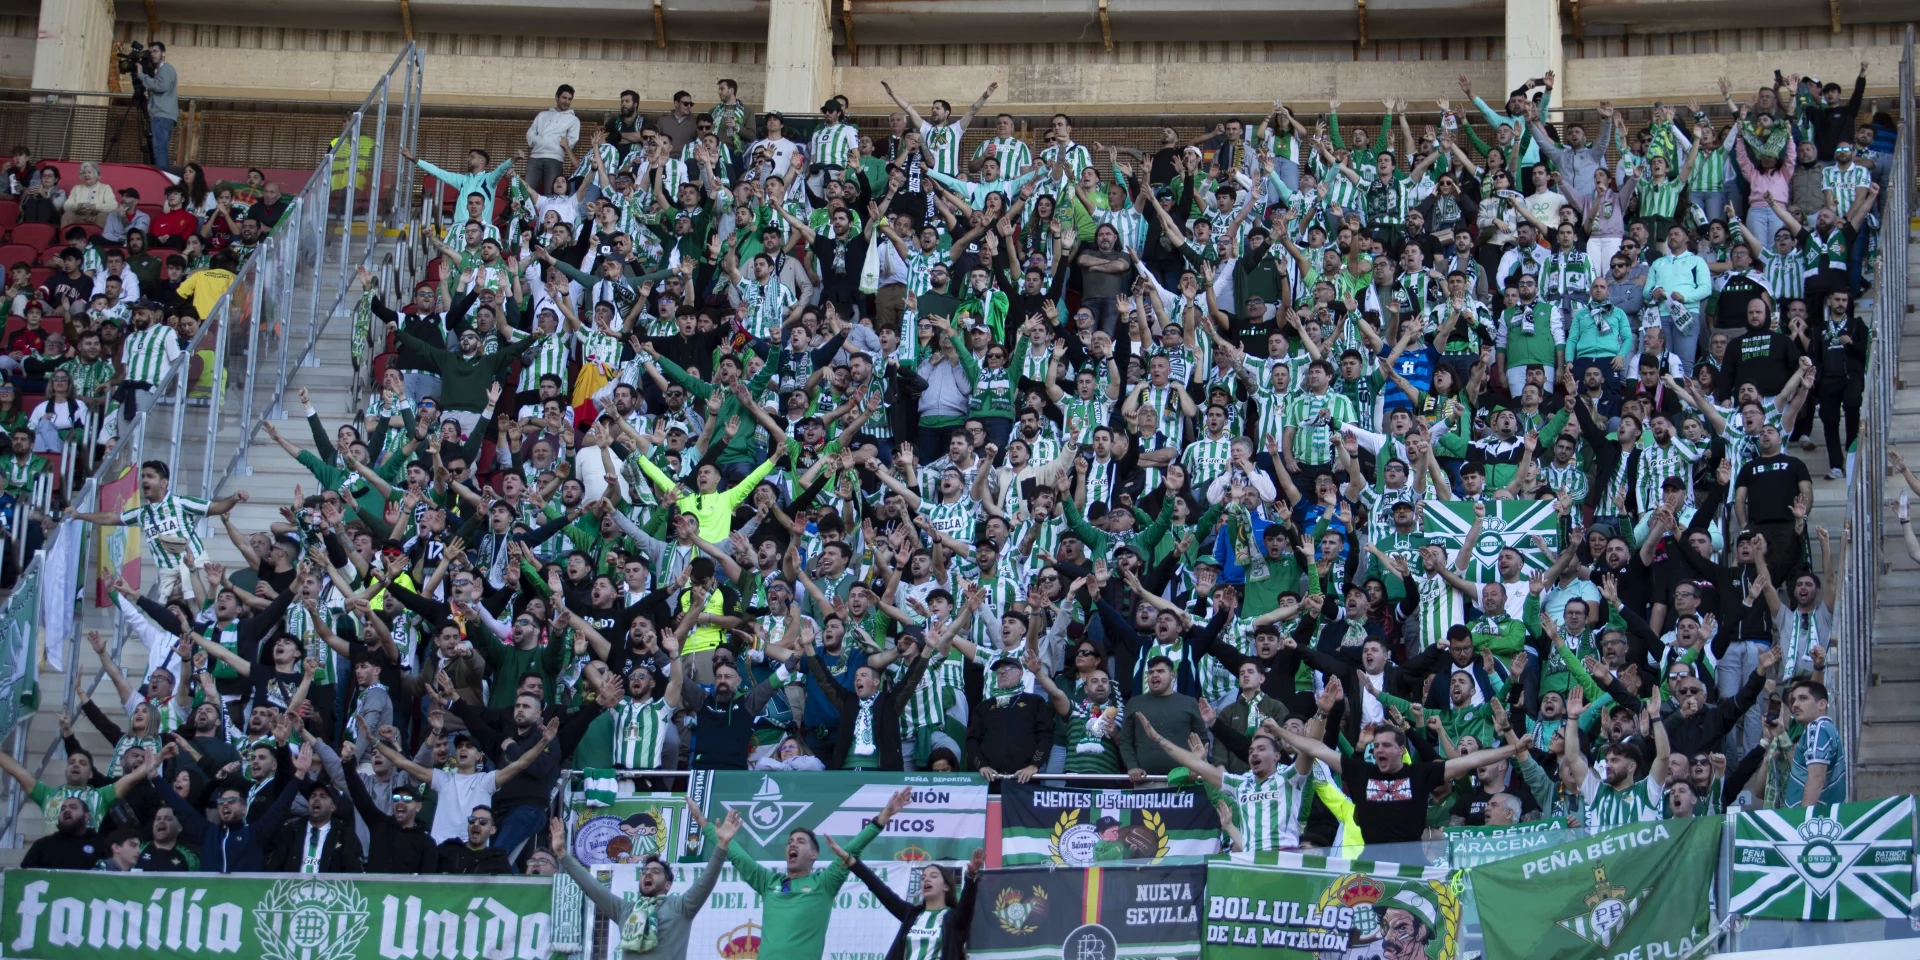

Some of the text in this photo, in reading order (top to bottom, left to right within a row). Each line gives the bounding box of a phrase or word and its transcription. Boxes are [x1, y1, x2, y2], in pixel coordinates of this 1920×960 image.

[925, 191, 935, 217] ONTIGO
[1093, 401, 1102, 424] ESCUDO
[1090, 478, 1108, 486] GRE
[693, 770, 706, 808] POLÍGON
[908, 788, 950, 804] NIÓN
[1248, 790, 1280, 801] GREE
[1033, 790, 1195, 809] FUENTES DE ANDALUCÍA
[1738, 796, 1746, 805] 6
[861, 818, 935, 832] BTICOS
[1491, 820, 1561, 840] BÉTICA
[1062, 825, 1082, 846] SOCIEDAD
[1455, 833, 1548, 853] ARACENA
[1521, 823, 1670, 880] PEÑA BÉTICA
[1742, 848, 1765, 857] PEÑA
[1874, 849, 1908, 858] PATRICK
[303, 857, 320, 866] GR
[711, 892, 748, 909] DEL
[1135, 883, 1192, 902] NUEVA
[1126, 905, 1198, 925] SEVILLA
[1208, 896, 1355, 931] BOLLULLOS
[1206, 925, 1350, 952] DE LA MITACIÓN
